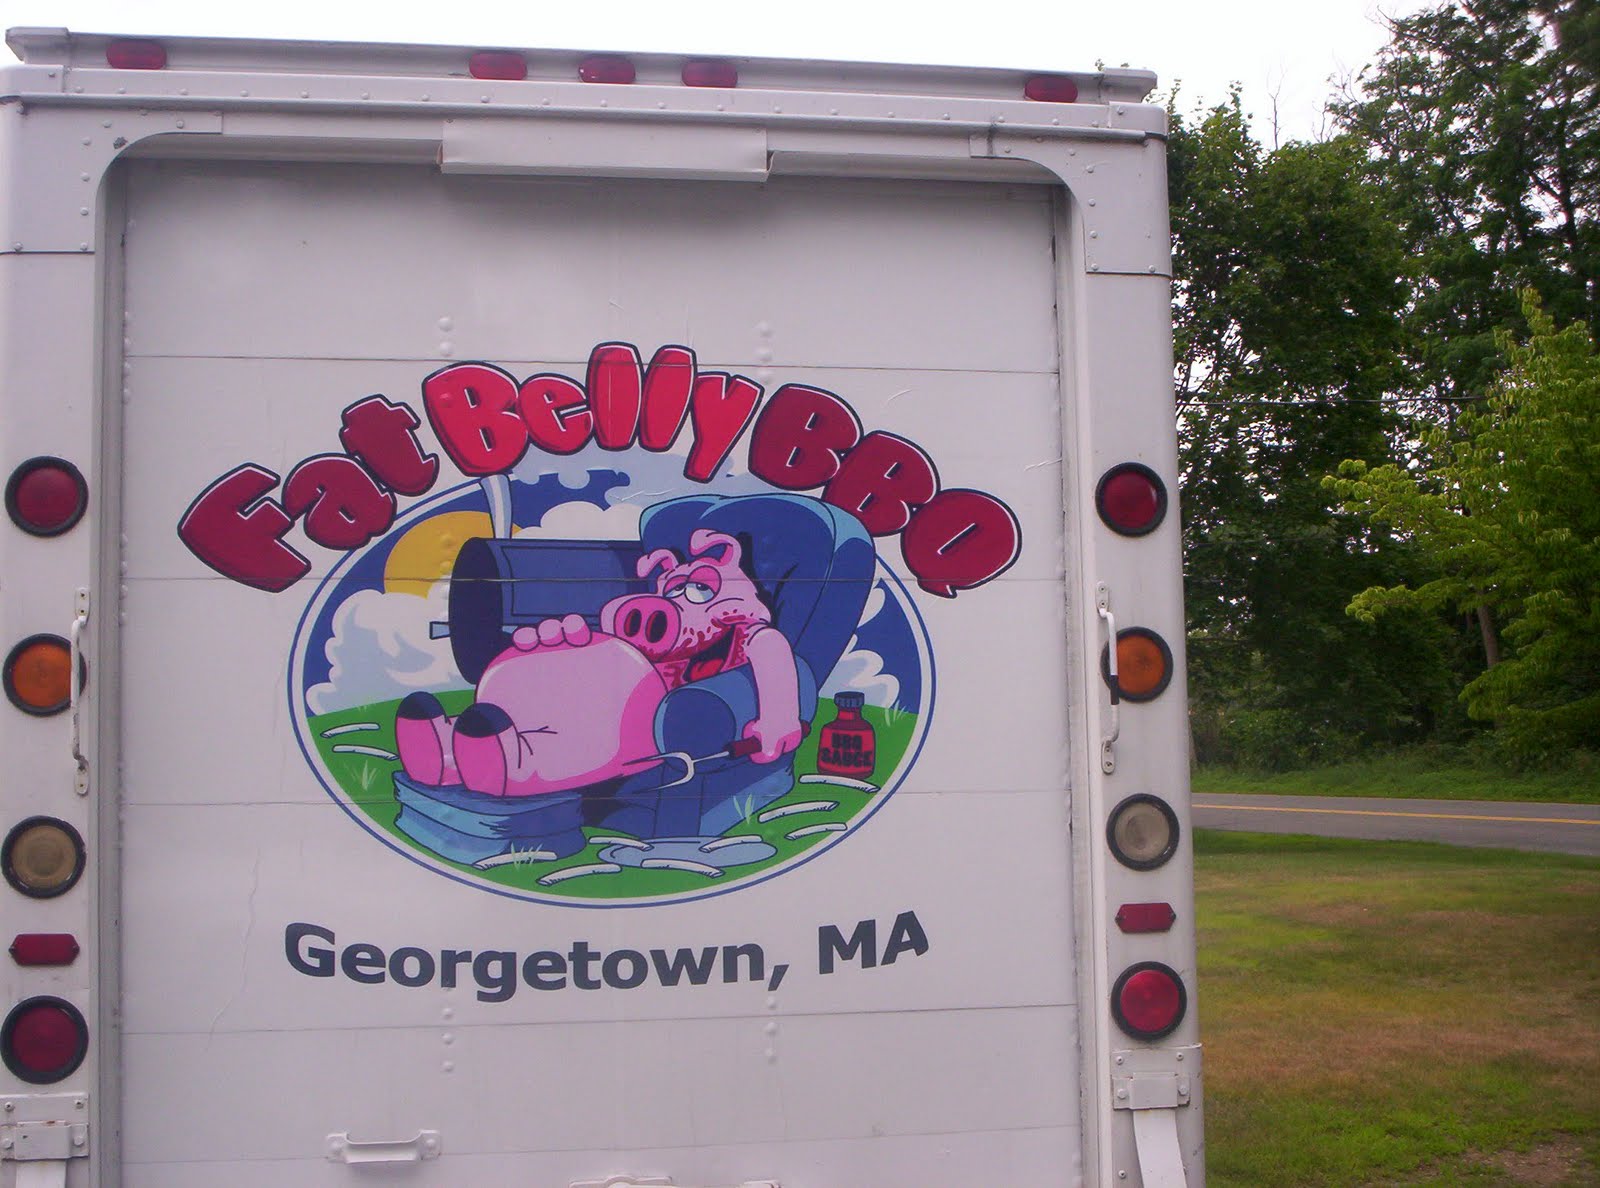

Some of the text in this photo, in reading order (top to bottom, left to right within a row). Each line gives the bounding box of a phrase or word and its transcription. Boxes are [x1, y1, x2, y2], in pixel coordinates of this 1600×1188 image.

[177, 341, 1022, 599] Fat Belly BBQ
[821, 747, 873, 768] SAUCE
[832, 731, 863, 751] BBQ
[284, 910, 930, 1003] Georgetown, MA
